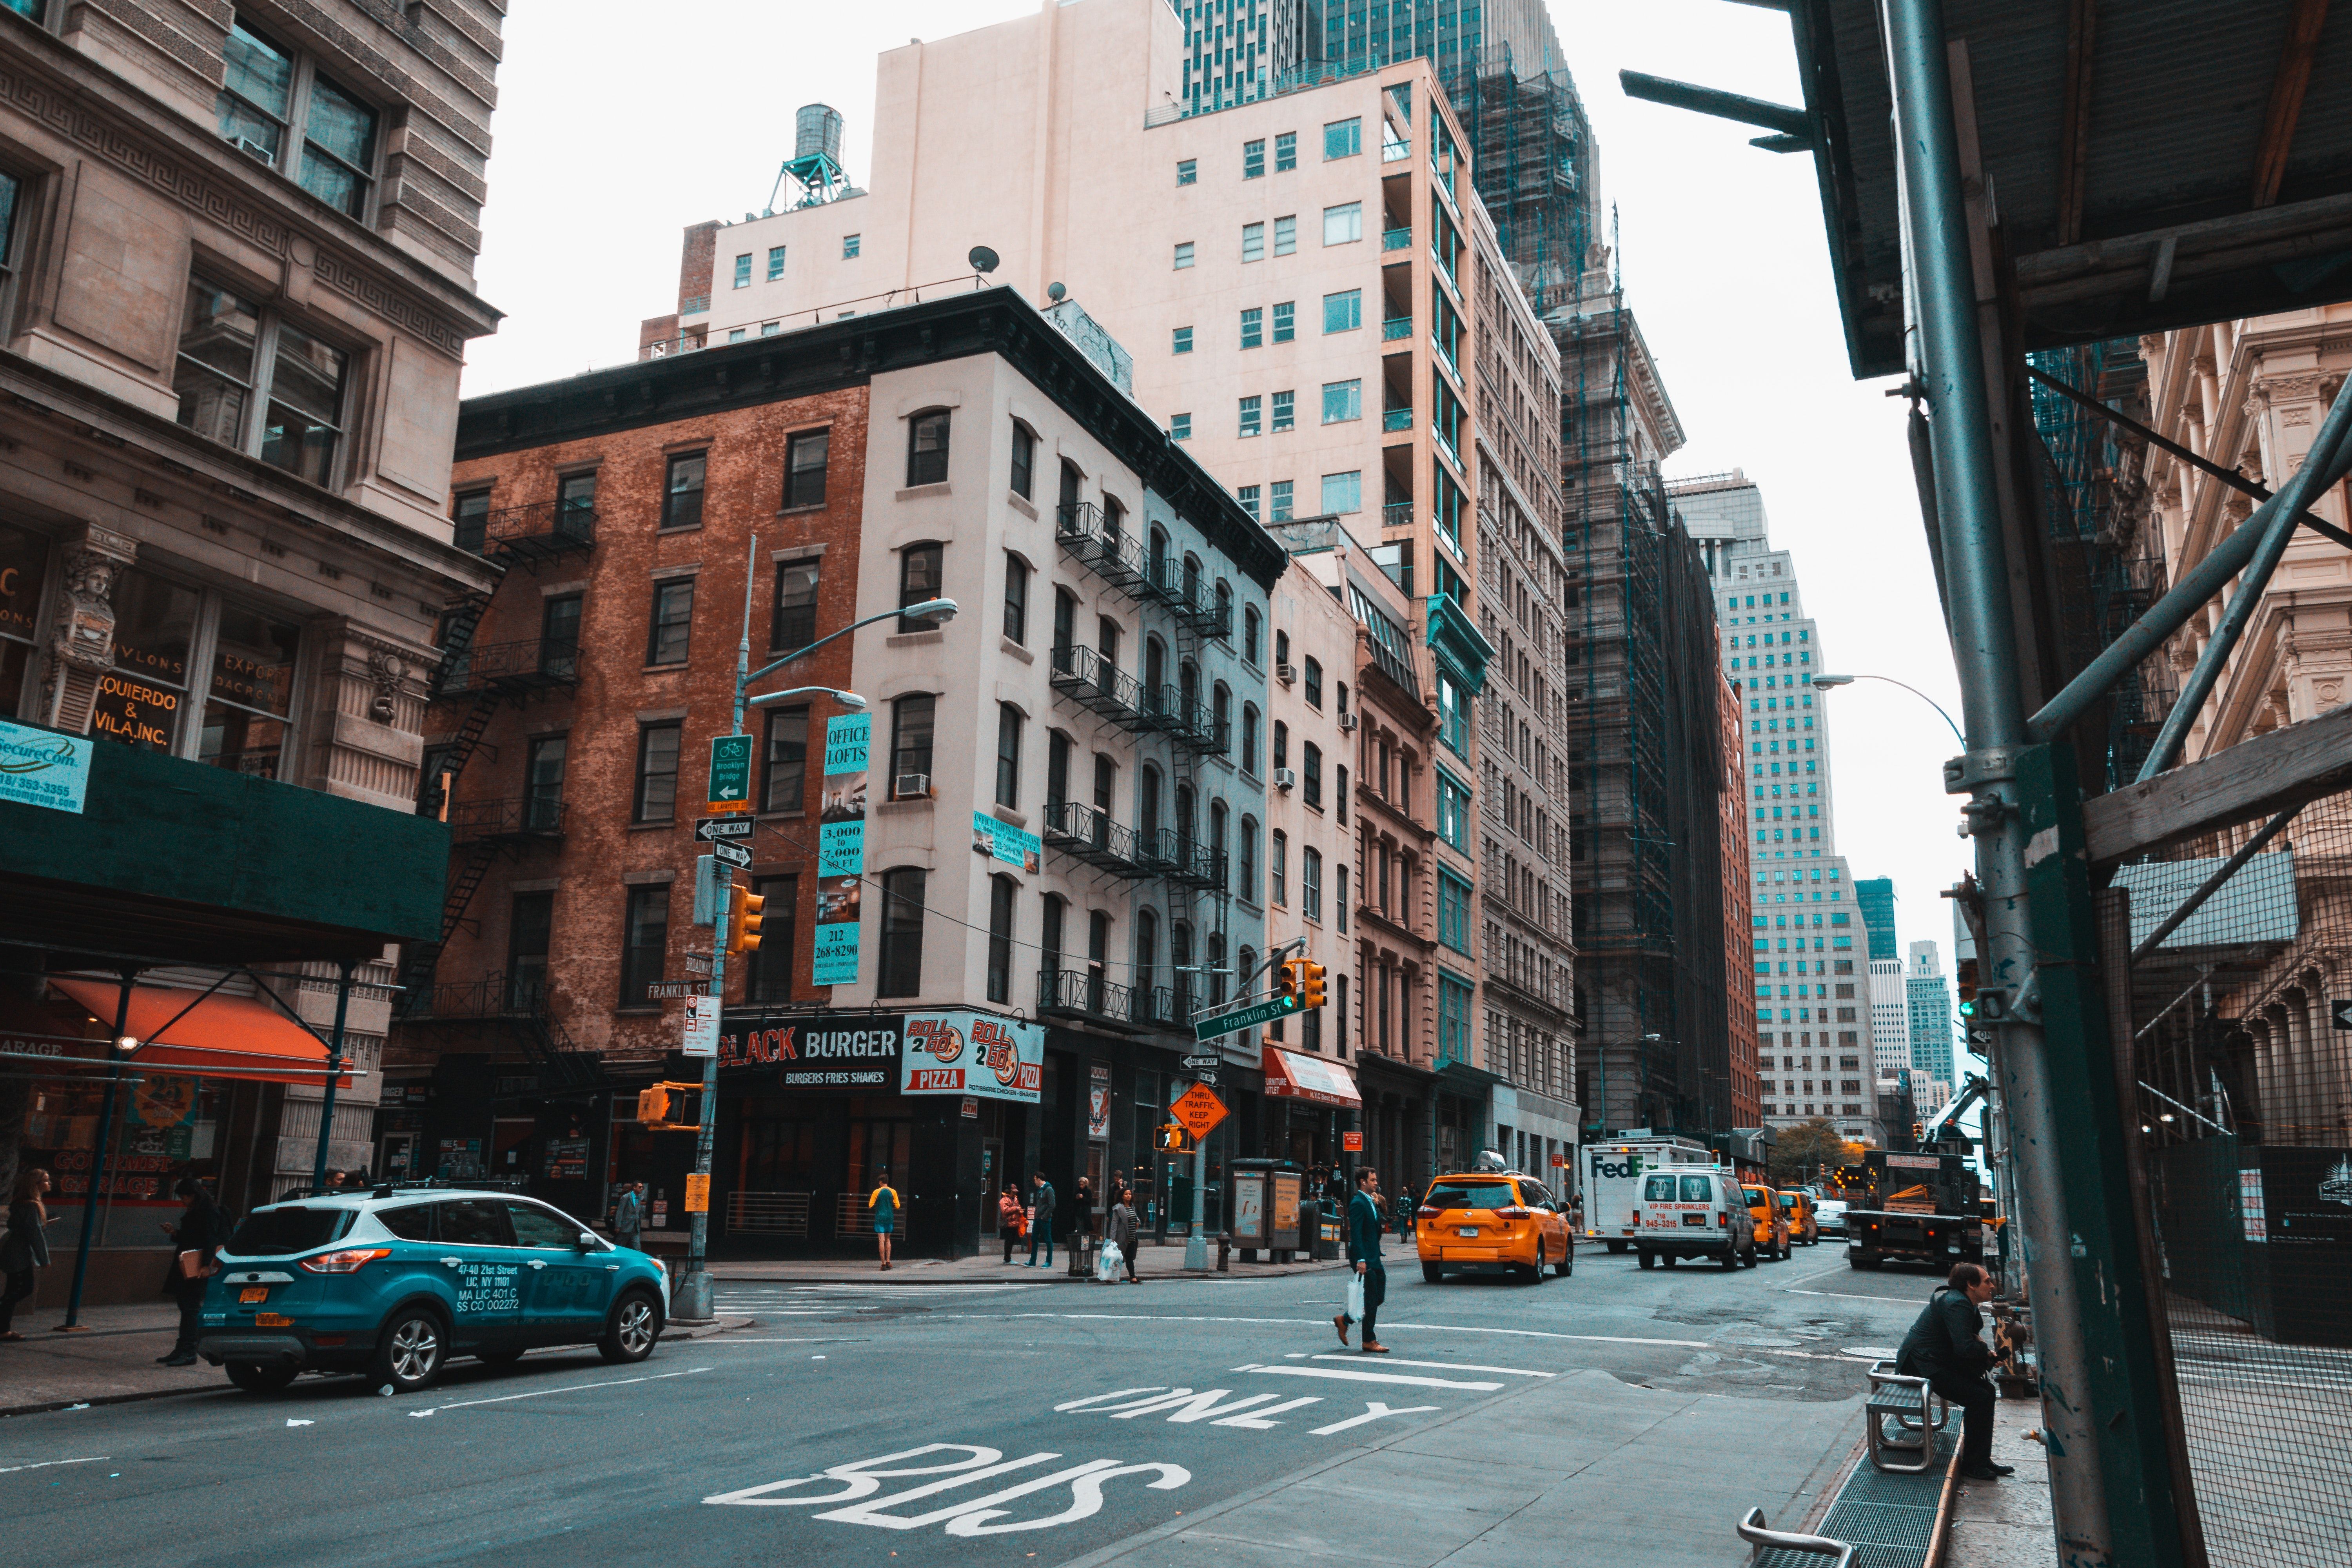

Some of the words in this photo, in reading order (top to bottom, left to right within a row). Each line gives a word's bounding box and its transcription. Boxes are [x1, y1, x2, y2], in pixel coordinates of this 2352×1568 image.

[225, 653, 285, 686] EXPORT
[124, 702, 137, 719] &
[829, 726, 869, 745] OFFICE
[828, 746, 866, 765] LOFTS
[716, 762, 745, 770] Brooklyn
[719, 772, 740, 781] Bridge
[706, 825, 724, 835] ONE
[729, 824, 746, 833] WAY
[824, 826, 860, 840] 3,000
[975, 813, 994, 828] OFFICE
[995, 821, 1011, 835] LOFTS
[1013, 829, 1023, 840] FOR
[1024, 832, 1040, 846] LEASE
[837, 838, 846, 847] to
[719, 846, 731, 858] ONE
[736, 851, 747, 862] WAY
[824, 847, 860, 859] 7,000
[827, 860, 839, 869] SQ
[842, 858, 854, 867] FT
[829, 929, 844, 942] 212
[815, 944, 858, 959] 268-8290
[686, 956, 712, 975] BROADWAY
[648, 984, 692, 998] FRANKLIN
[697, 984, 708, 996] ST
[1223, 1009, 1267, 1029] Franklin
[1271, 1004, 1282, 1015] St
[906, 1019, 951, 1038] ROLL
[970, 1019, 1010, 1048] ROLL
[0, 1039, 63, 1057] ARAGE
[717, 1026, 798, 1068] BLACK
[805, 1030, 897, 1058] BURGER
[911, 1038, 924, 1053] 2
[924, 1031, 951, 1053] GO
[975, 1045, 986, 1066] 2
[986, 1040, 1009, 1071] GO
[786, 1073, 824, 1084] BURGERS
[825, 1072, 849, 1083] FRIES
[850, 1071, 884, 1083] SHAKES
[920, 1070, 958, 1088] PIZZA
[1020, 1065, 1040, 1089] PIZZA
[968, 1084, 996, 1093] ROTISSERIE
[997, 1087, 1017, 1096] CHICKEN
[1019, 1090, 1038, 1098] SHAKES
[1190, 1091, 1210, 1100] THRU
[1321, 1093, 1330, 1101] Best
[1331, 1094, 1340, 1103] Deal
[962, 1103, 977, 1114] ATM
[1185, 1100, 1215, 1110] TRAFFIC
[1188, 1120, 1210, 1129] RIGHT
[1646, 1220, 1677, 1228] 945-3315
[458, 1265, 479, 1275] 47-40
[481, 1265, 495, 1275] 21st
[497, 1265, 518, 1275] Street
[466, 1276, 479, 1288] LIC,
[481, 1276, 492, 1287] NY
[494, 1276, 510, 1287] 11101
[459, 1290, 473, 1301] MA
[476, 1289, 490, 1300] LIC
[492, 1289, 508, 1299] 401
[510, 1288, 517, 1298] C
[457, 1301, 468, 1312] SS
[487, 1299, 519, 1310] 002272
[1053, 1386, 1442, 1436] ONLY
[701, 1443, 1192, 1536] BUS
